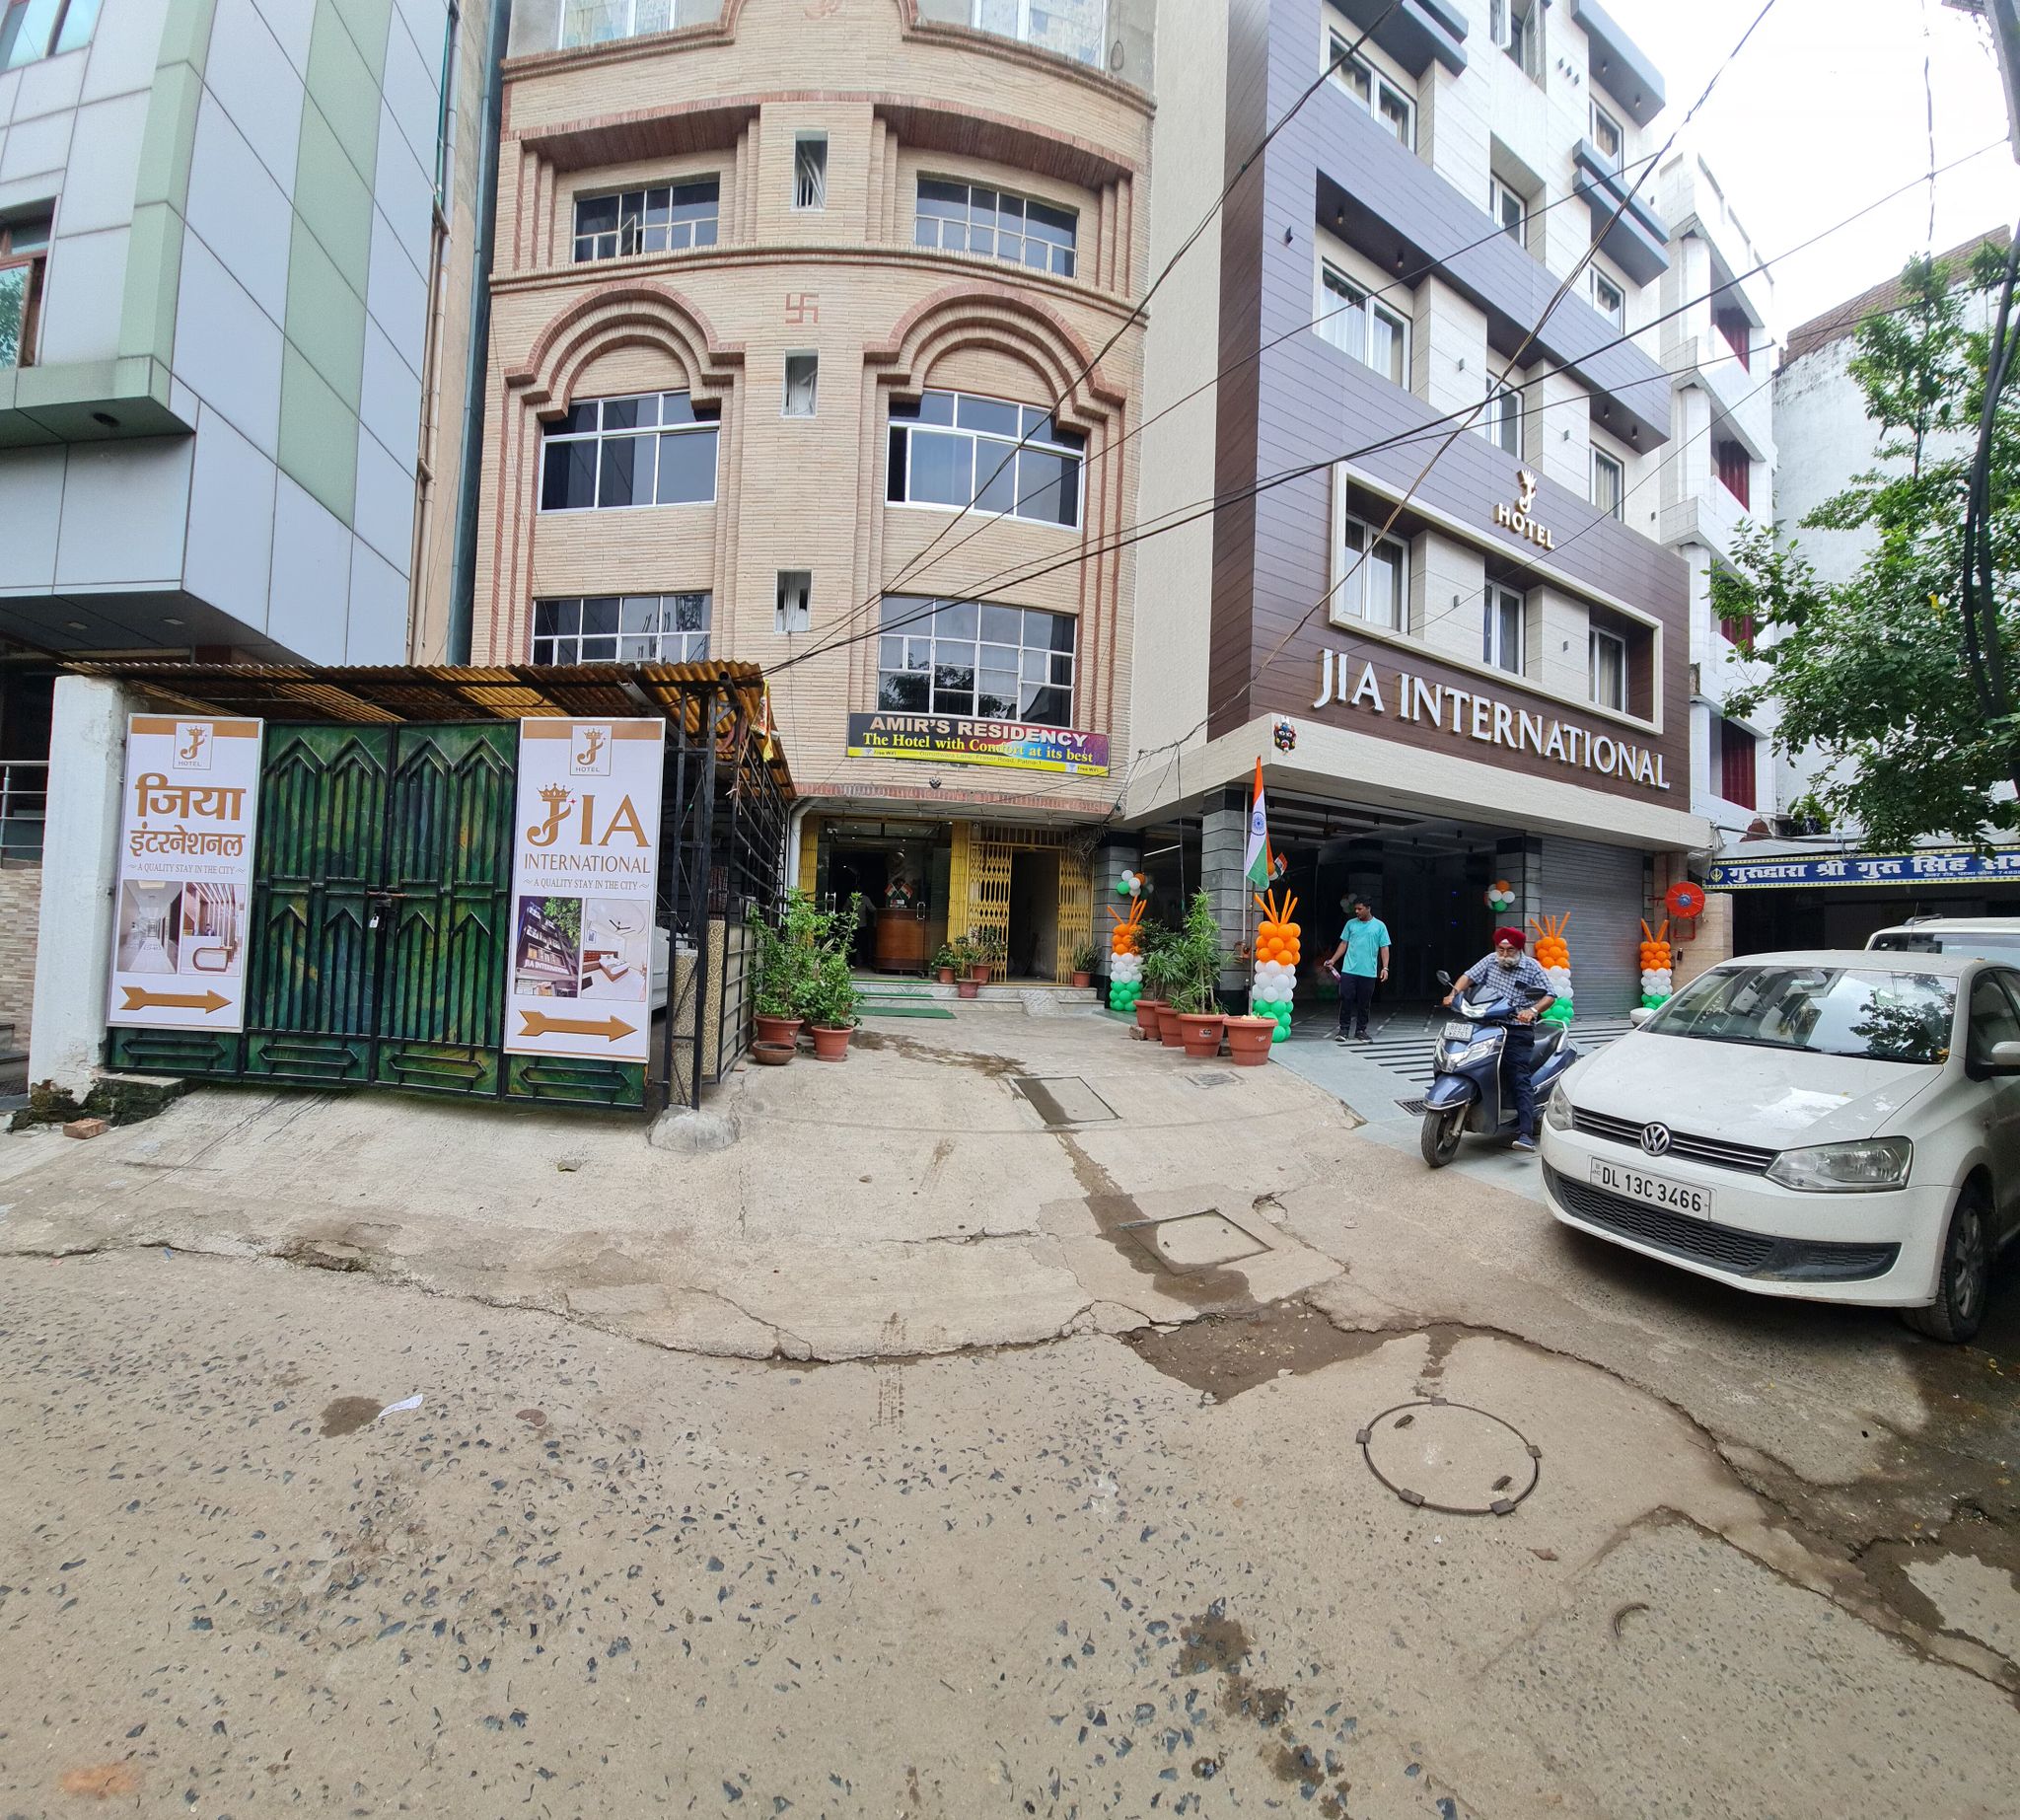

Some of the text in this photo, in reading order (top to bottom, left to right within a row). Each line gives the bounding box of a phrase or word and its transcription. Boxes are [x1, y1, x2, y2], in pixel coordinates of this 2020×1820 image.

[1496, 502, 1554, 549] HOTEL
[869, 716, 1088, 748] AMIR'S RESIDENCY
[1312, 648, 1671, 790] JIA INTERNATIONAL
[862, 732, 1094, 763] The Hotel with Comfort at its best
[135, 772, 246, 821] जिया
[527, 783, 652, 847] JIA
[129, 821, 246, 856] इंटरनेशनल
[144, 863, 175, 873] QUALITY
[175, 864, 194, 873] STAY
[194, 865, 202, 874] IN
[203, 865, 217, 874] THE
[218, 866, 236, 875] CITY
[524, 853, 651, 874] INTERNATIONAL
[1816, 859, 1848, 877] श्री
[1911, 854, 1970, 873] सिंह
[534, 878, 638, 891] A QUALITY STAY IN THE CITY
